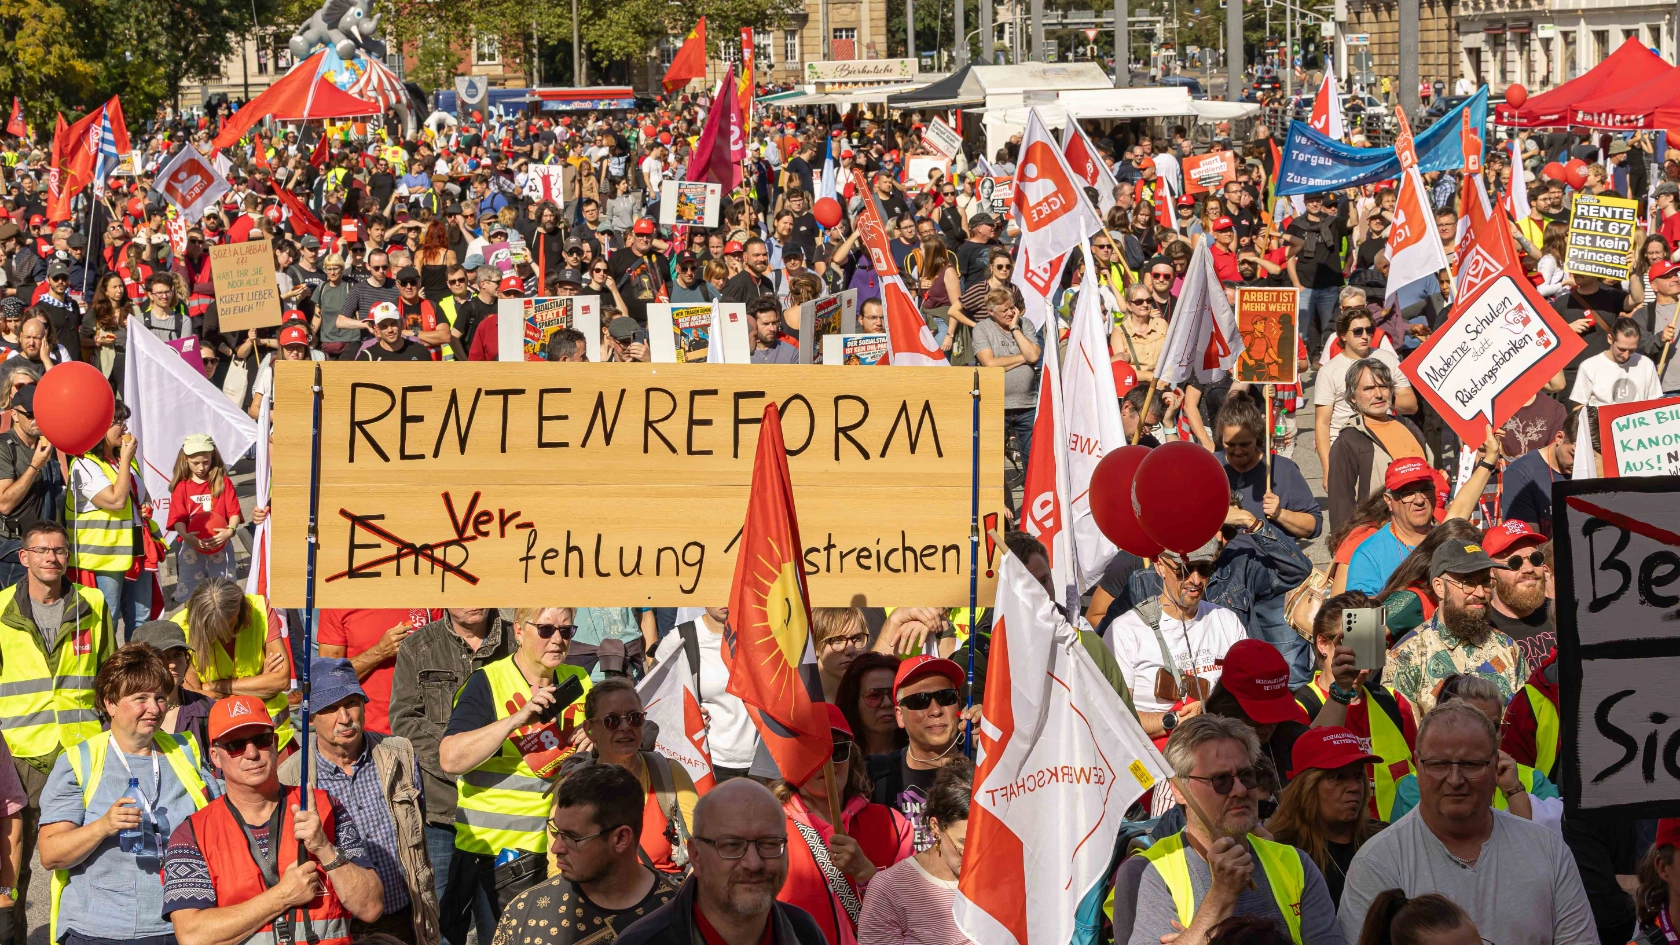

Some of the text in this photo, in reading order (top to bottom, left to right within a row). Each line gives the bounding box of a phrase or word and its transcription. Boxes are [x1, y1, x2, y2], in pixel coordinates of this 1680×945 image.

[835, 63, 895, 78] Bierkutsche
[1202, 158, 1219, 167] Hart
[1292, 150, 1332, 166] Torgau
[1193, 164, 1226, 176] verdient!
[1286, 172, 1347, 187] Zusammen
[1577, 204, 1634, 220] RENTE
[1573, 218, 1631, 236] mit 67
[1571, 233, 1629, 251] ist kein
[1569, 248, 1627, 265] Princess
[216, 266, 264, 281] HABT IHR SIE
[1568, 261, 1627, 278] Treatment!
[228, 279, 244, 289] NOCH
[245, 278, 260, 287] ALLE
[247, 288, 275, 302] LIEBER
[1243, 291, 1294, 302] ARBEIT IST
[220, 307, 231, 316] BEI
[233, 304, 254, 315] EUCH
[534, 299, 566, 313] SOZIALSTAAT
[1242, 302, 1295, 312] MEHR WERT!
[536, 308, 565, 322] STATT
[538, 317, 566, 330] SPARSTAAT
[847, 339, 858, 348] DER
[1424, 296, 1513, 389] Moderne Schulen
[1471, 337, 1494, 361] statt
[845, 347, 853, 355] IST
[1455, 333, 1533, 407] Rüstungsfabriken
[348, 382, 944, 463] RENTENREFORM
[1616, 417, 1650, 432] WIR
[1624, 454, 1662, 474] AUS!
[441, 490, 536, 540] Ver-
[347, 512, 471, 593] Emp
[518, 528, 706, 594] fehlung
[803, 530, 961, 576] streichen
[539, 730, 559, 750] 8
